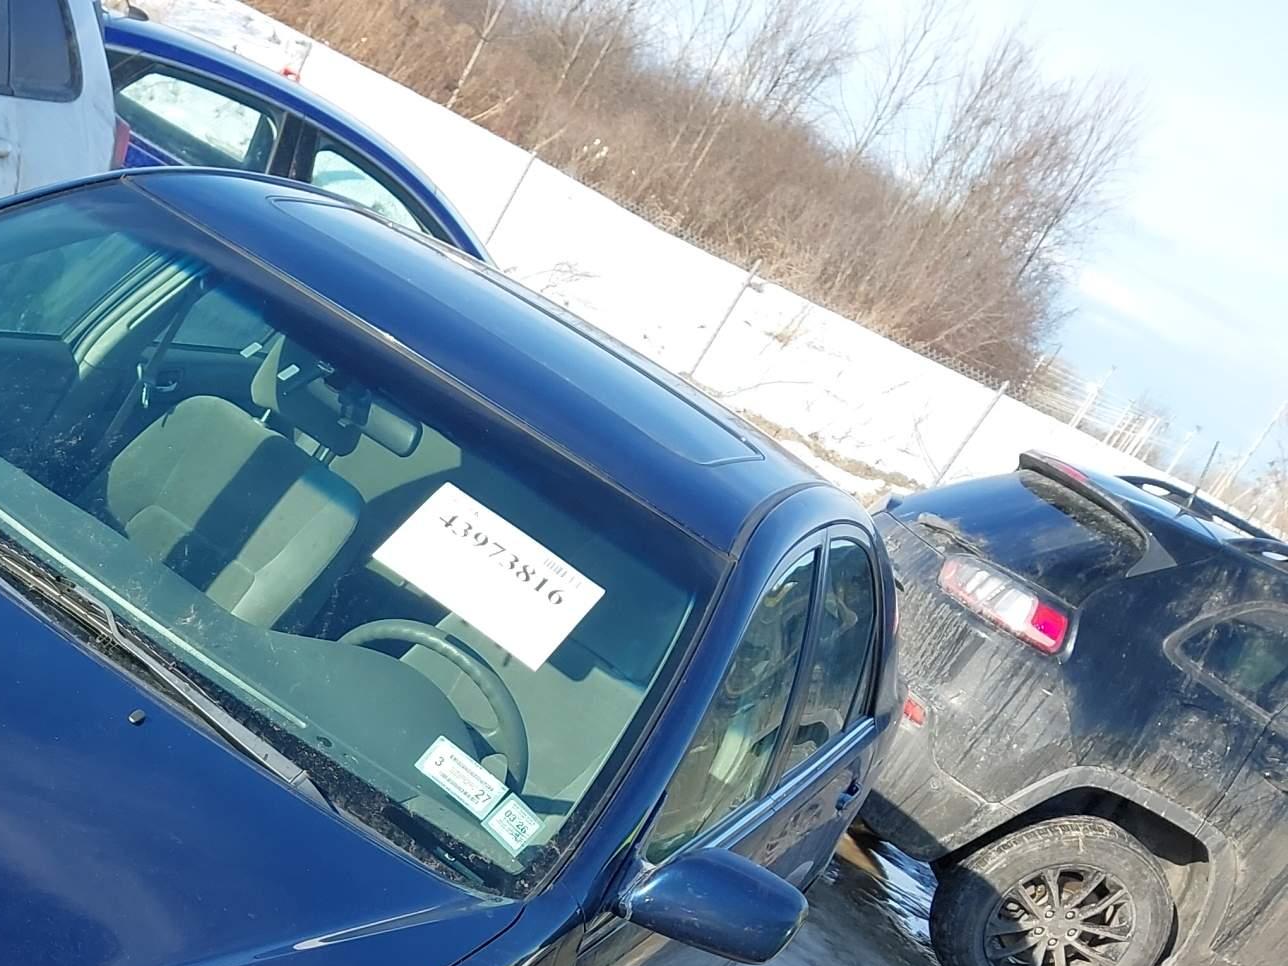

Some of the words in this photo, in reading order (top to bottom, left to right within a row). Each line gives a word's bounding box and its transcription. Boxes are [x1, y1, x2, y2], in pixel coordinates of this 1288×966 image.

[439, 514, 565, 605] 43973816
[434, 755, 445, 767] 3
[473, 789, 492, 804] 27
[516, 821, 528, 834] 26
